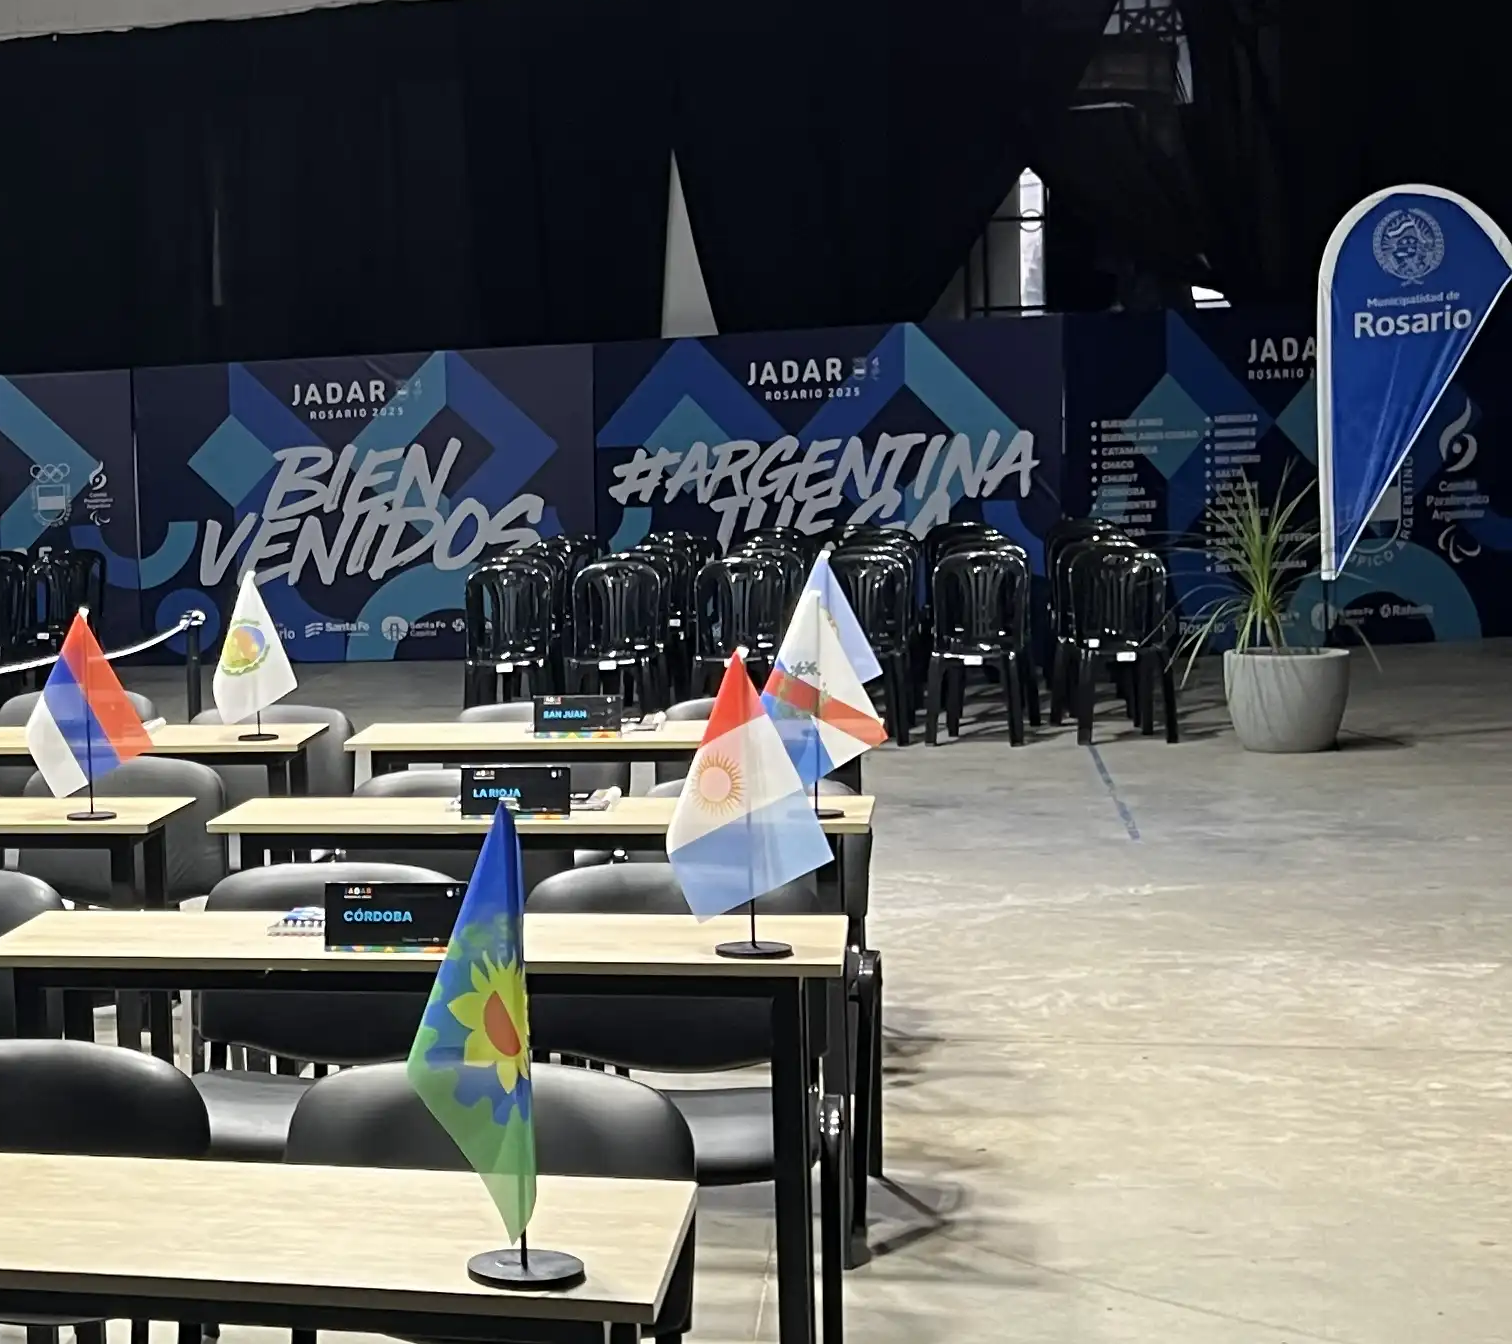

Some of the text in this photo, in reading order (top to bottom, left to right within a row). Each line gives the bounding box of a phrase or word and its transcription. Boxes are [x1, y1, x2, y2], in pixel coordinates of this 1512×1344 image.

[1367, 291, 1460, 308] Municipalidad de
[1354, 305, 1472, 339] Rosario
[1248, 337, 1317, 364] JADA
[748, 357, 842, 386] JADAR
[1248, 368, 1304, 380] ROSARIO
[292, 380, 386, 407] JADAR
[765, 386, 861, 401] ROSARIO 2025
[309, 408, 367, 420] ROSARIO
[607, 429, 1040, 505] #ARGENTINA
[263, 437, 462, 523] BIEN
[199, 493, 545, 587] VENIDOS
[325, 621, 370, 632] Santa Fe
[562, 710, 587, 719] JUAN
[473, 788, 521, 798] LA RIOJA
[343, 908, 413, 923] CÓRDOBA
